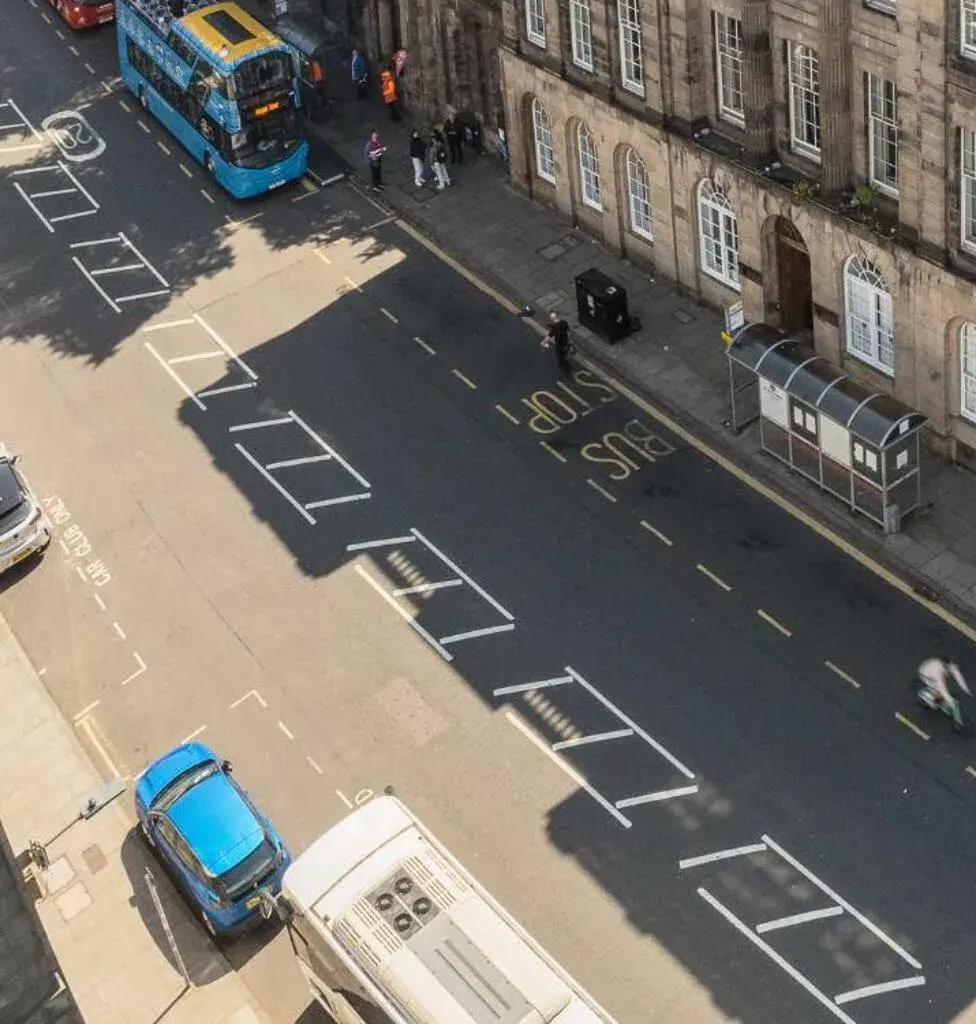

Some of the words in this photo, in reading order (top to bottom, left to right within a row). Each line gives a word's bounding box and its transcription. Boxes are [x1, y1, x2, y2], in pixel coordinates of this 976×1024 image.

[521, 369, 619, 435] STOP
[580, 419, 677, 480] BUS
[63, 524, 92, 557] CLUB
[86, 559, 112, 587] CAR
